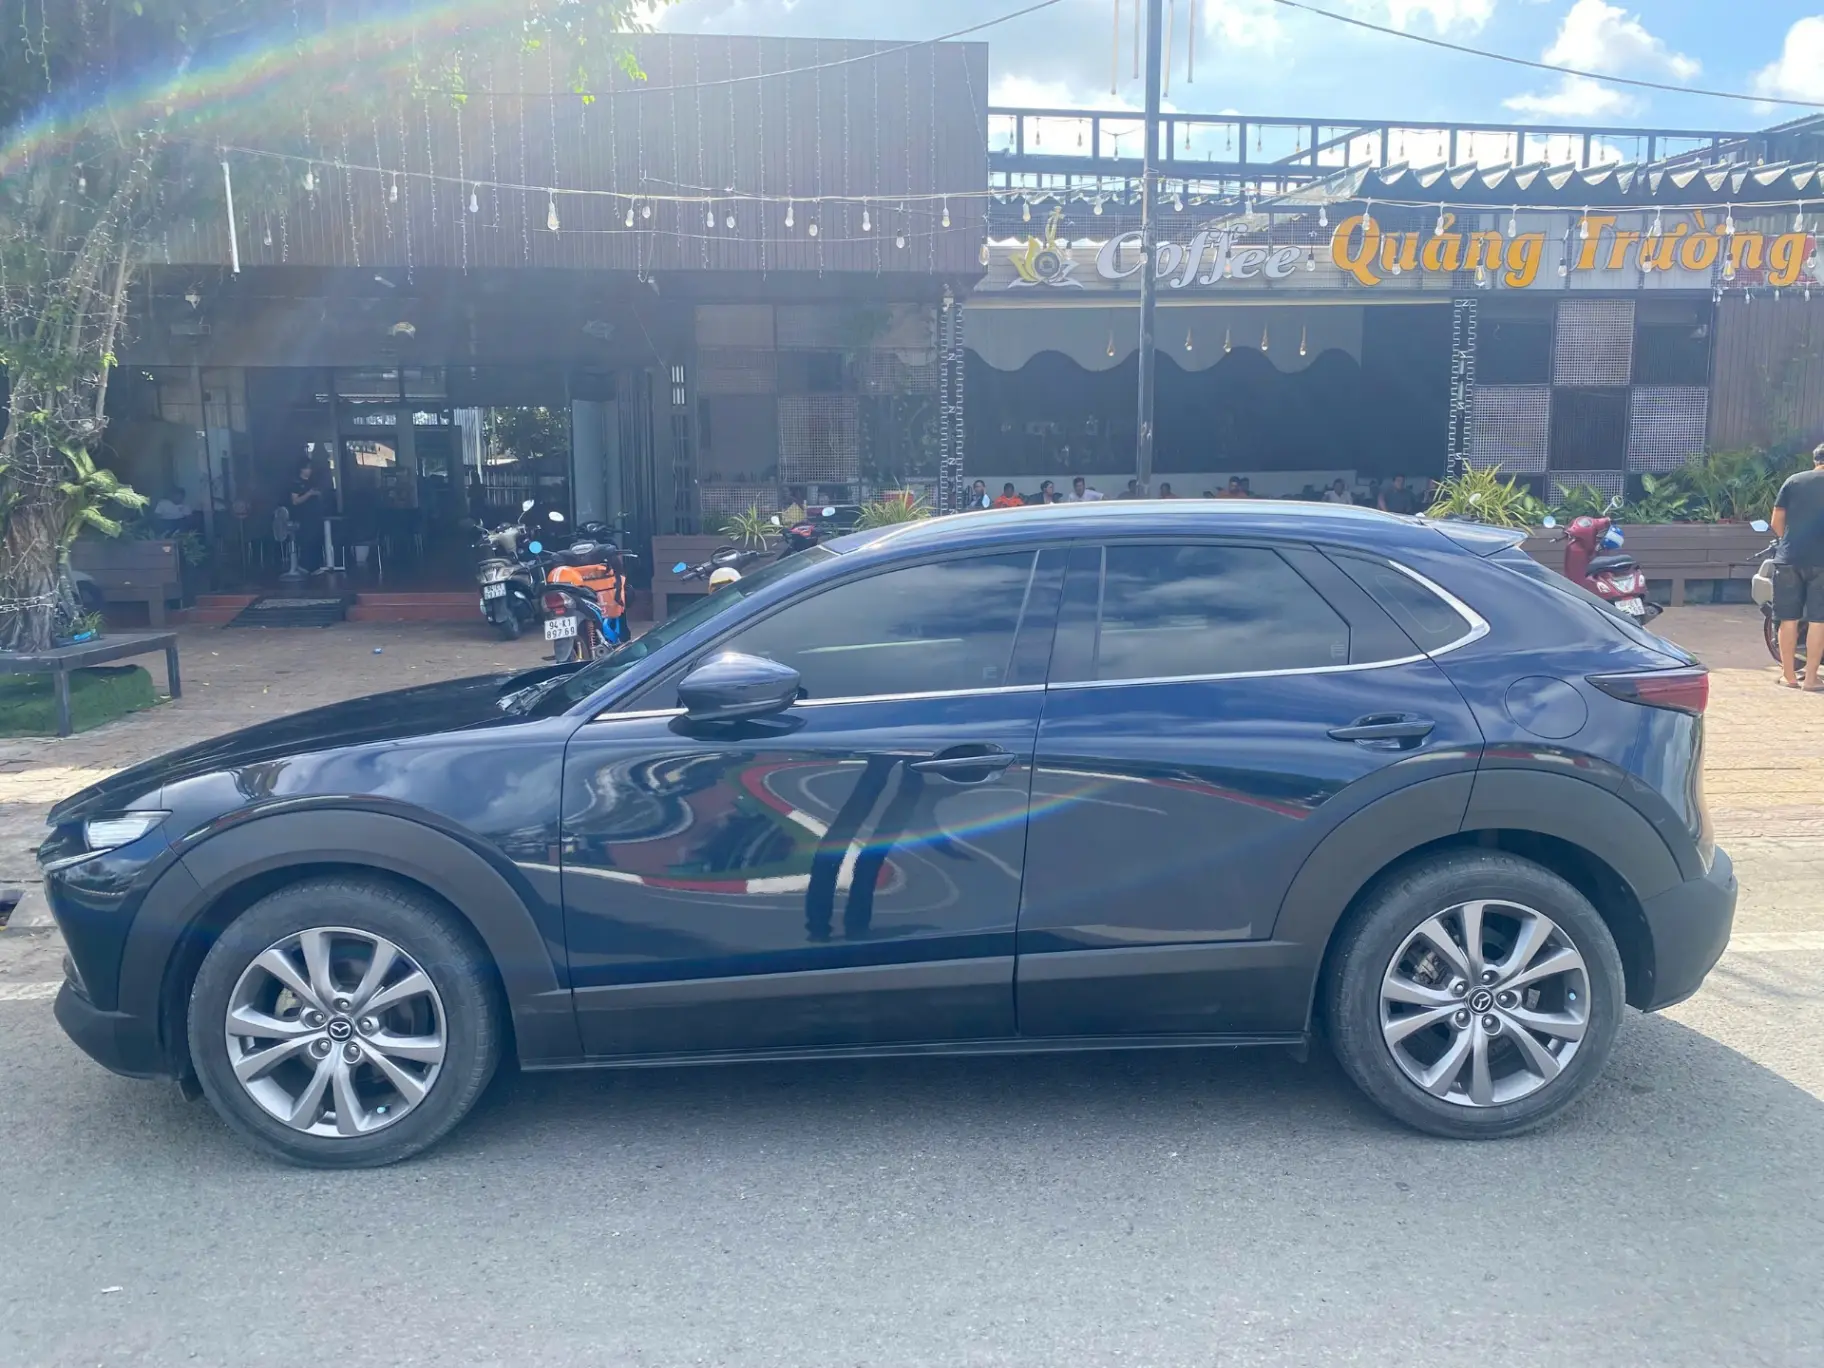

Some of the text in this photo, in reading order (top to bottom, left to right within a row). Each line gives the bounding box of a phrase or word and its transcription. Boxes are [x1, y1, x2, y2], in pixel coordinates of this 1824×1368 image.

[1096, 209, 1807, 288] Coffee Quảng Trường
